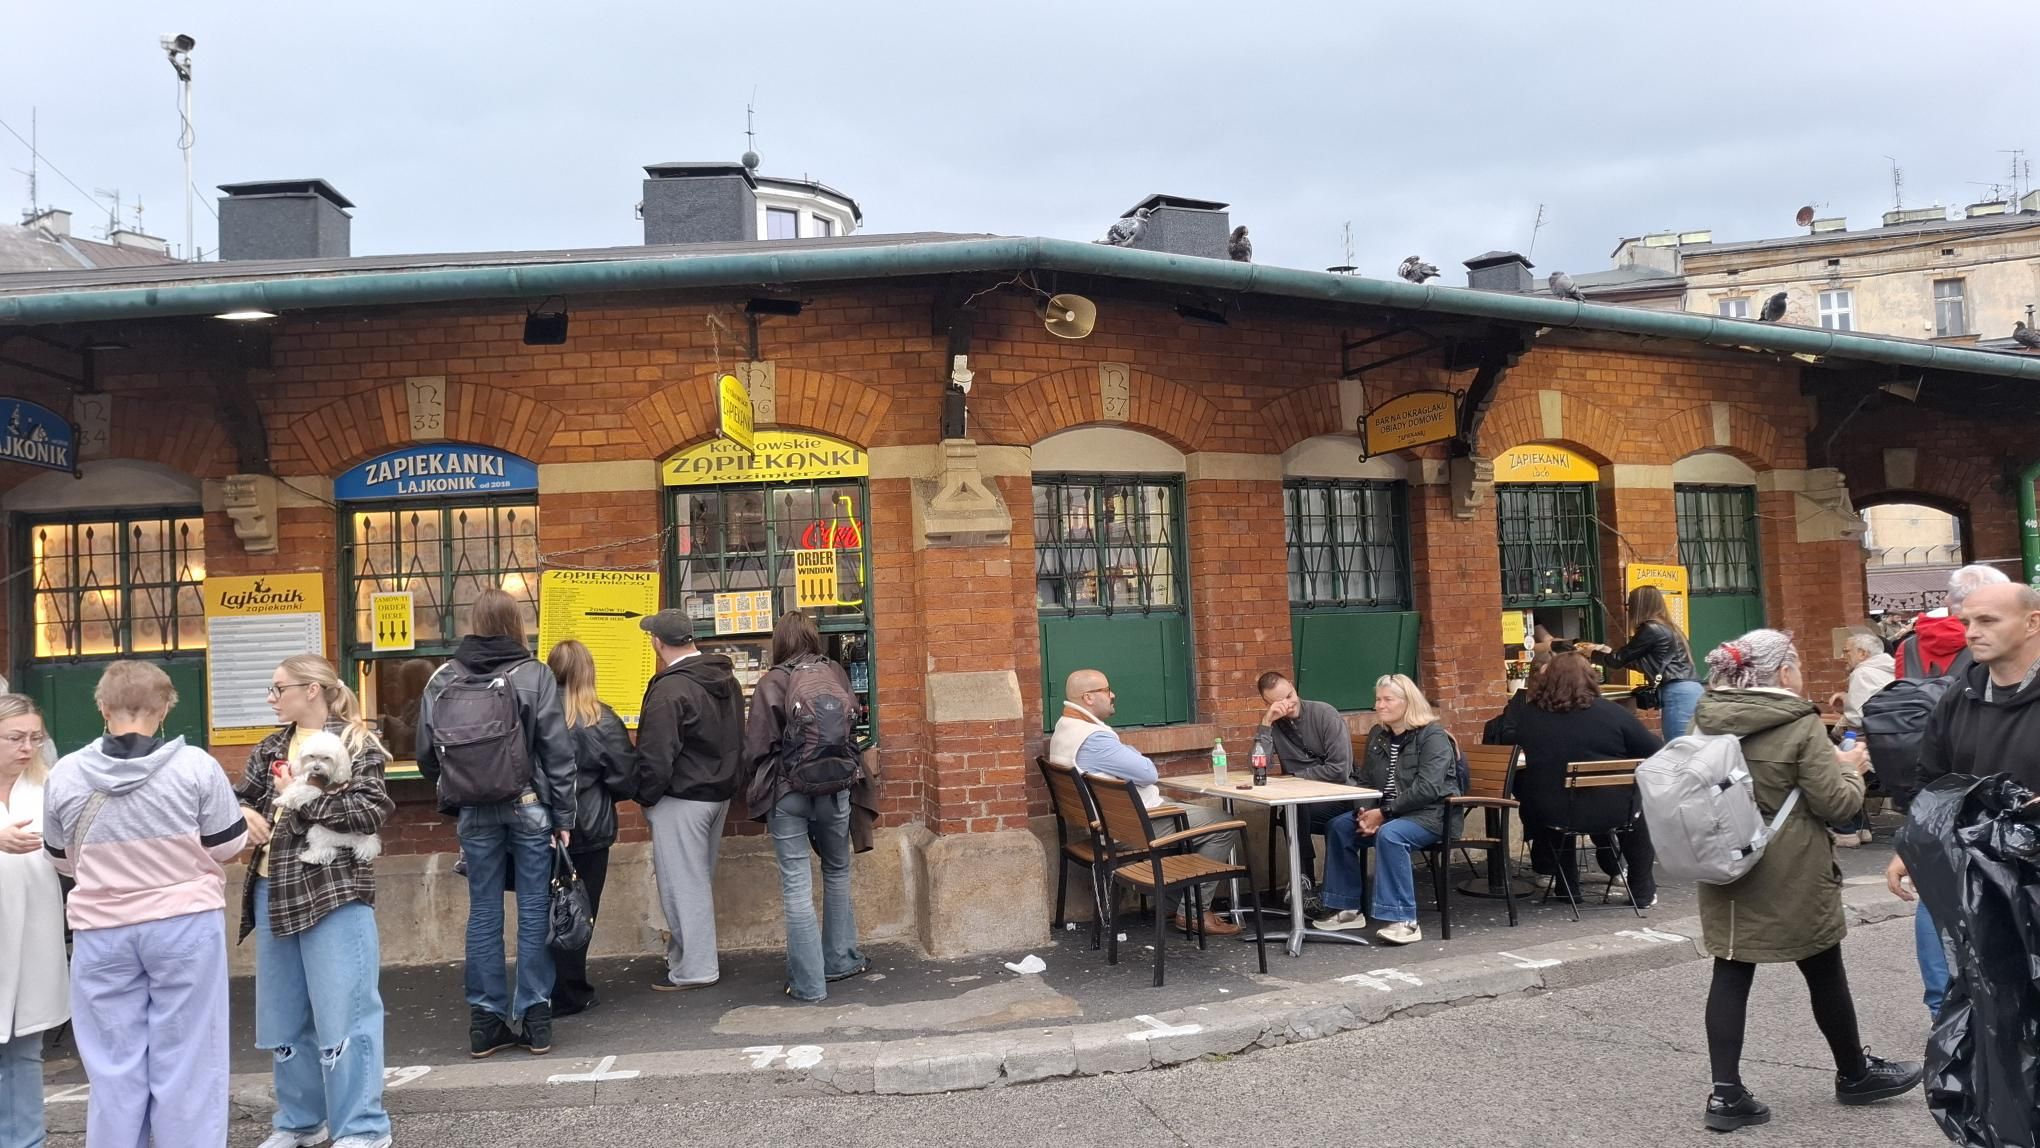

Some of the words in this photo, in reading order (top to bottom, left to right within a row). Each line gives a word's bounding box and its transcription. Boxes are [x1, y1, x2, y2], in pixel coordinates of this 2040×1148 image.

[1105, 397, 1128, 416] 37
[414, 413, 440, 430] 35
[1408, 412, 1444, 428] DOMOWE
[365, 453, 505, 485] ZAPIEKANKI
[671, 450, 860, 475] ZAPIEKANKI
[1509, 453, 1571, 470] ZAPIEKANKI
[712, 469, 841, 482] Kazimierza
[398, 476, 476, 494] LAJKONIK
[479, 481, 490, 489] od
[797, 551, 834, 567] ORDER
[552, 571, 651, 581] ZAPIEKANKI
[798, 566, 834, 575] WINDOW
[1636, 568, 1679, 582] ZAPIEKANKI
[220, 589, 305, 609] Lajkonik
[246, 603, 302, 613] zapiekanki
[742, 1045, 824, 1069] 78
